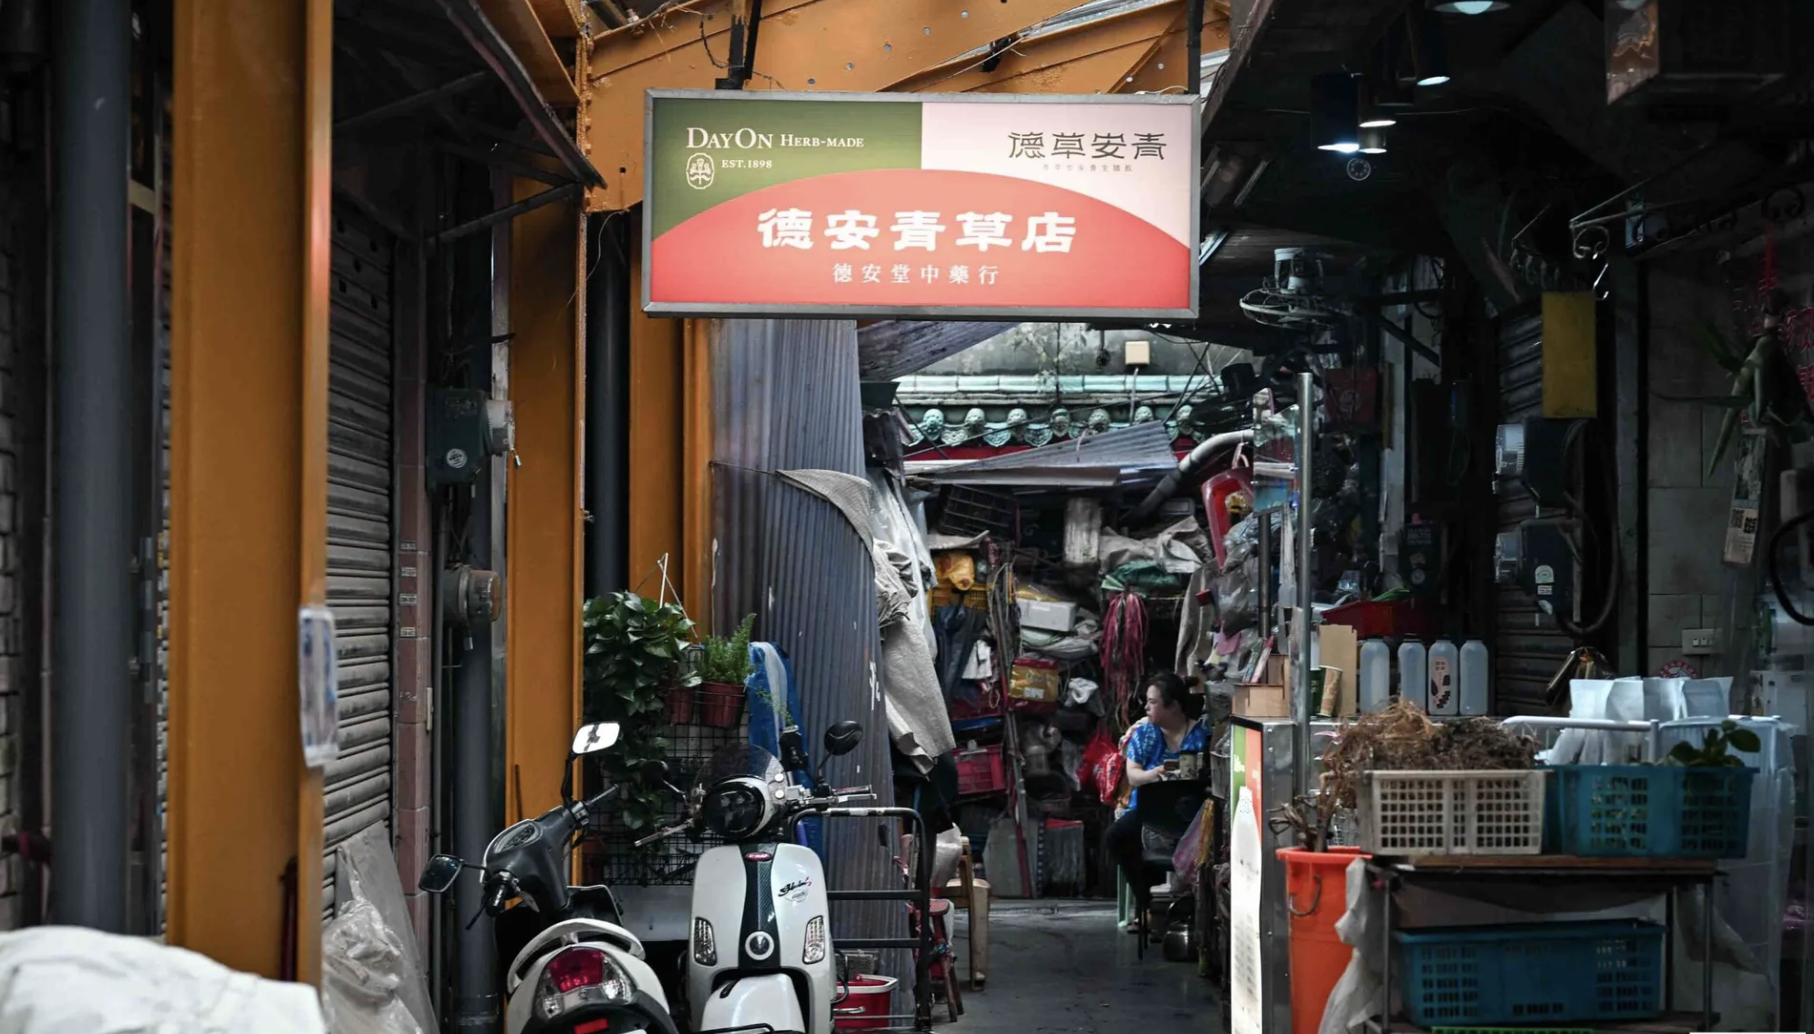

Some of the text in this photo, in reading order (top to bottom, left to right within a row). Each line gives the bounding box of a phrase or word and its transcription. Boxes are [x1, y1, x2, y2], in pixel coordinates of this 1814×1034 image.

[721, 159, 773, 169] EST.1898
[757, 208, 1077, 254] 德安青草店
[832, 263, 1000, 285] 德安堂中藥行
